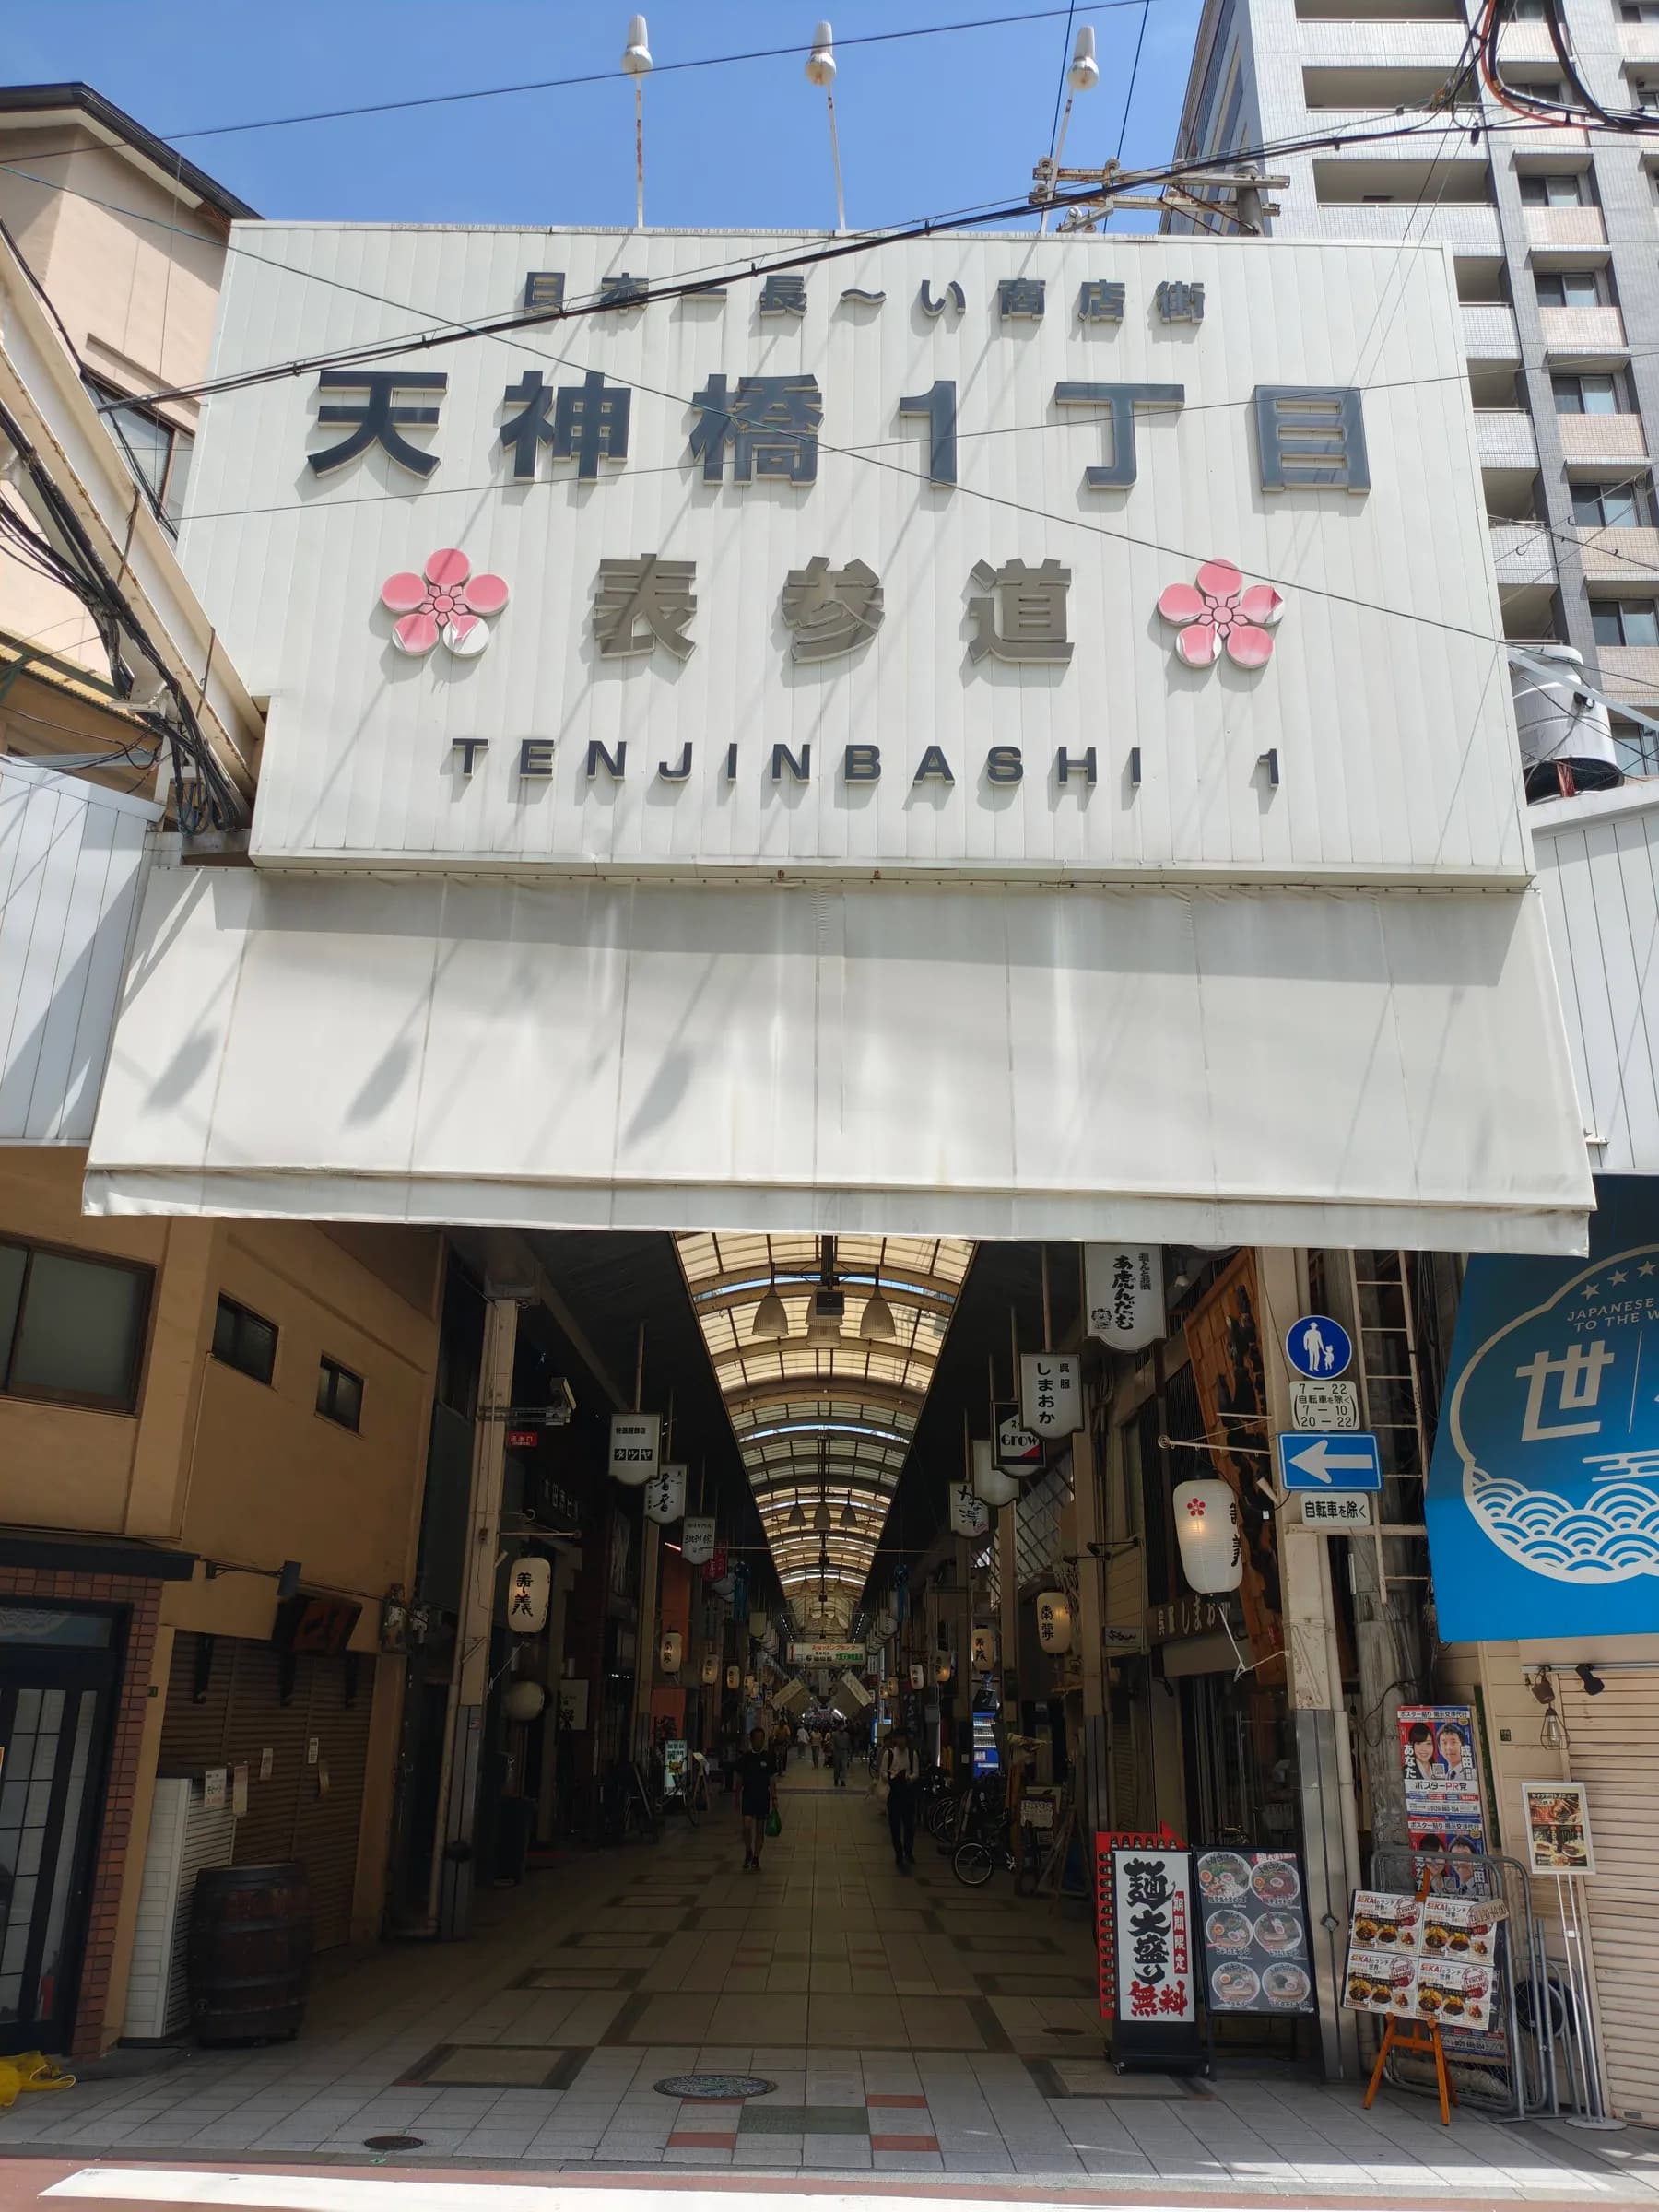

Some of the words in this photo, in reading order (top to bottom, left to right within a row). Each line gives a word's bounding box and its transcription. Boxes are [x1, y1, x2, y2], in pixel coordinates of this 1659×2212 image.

[307, 371, 1371, 495] 天神橋1丁目
[593, 553, 1075, 664] 表参道
[452, 738, 1142, 788] TENJINBASHI
[1257, 748, 1279, 788] 1
[1567, 1297, 1655, 1322] JAPANESE
[1573, 1320, 1597, 1333] TO
[1605, 1312, 1640, 1327] THE
[1036, 1362, 1055, 1424] しまおか
[1298, 1394, 1351, 1404] 自転車を除く
[1515, 1340, 1615, 1441] 世
[1304, 1500, 1367, 1519] 自転車を除く
[1404, 1744, 1417, 1779] あなた
[1415, 1782, 1467, 1791] ポスターPR党
[1172, 1896, 1186, 1971] 期間限定
[1127, 1980, 1188, 2017] 無料
